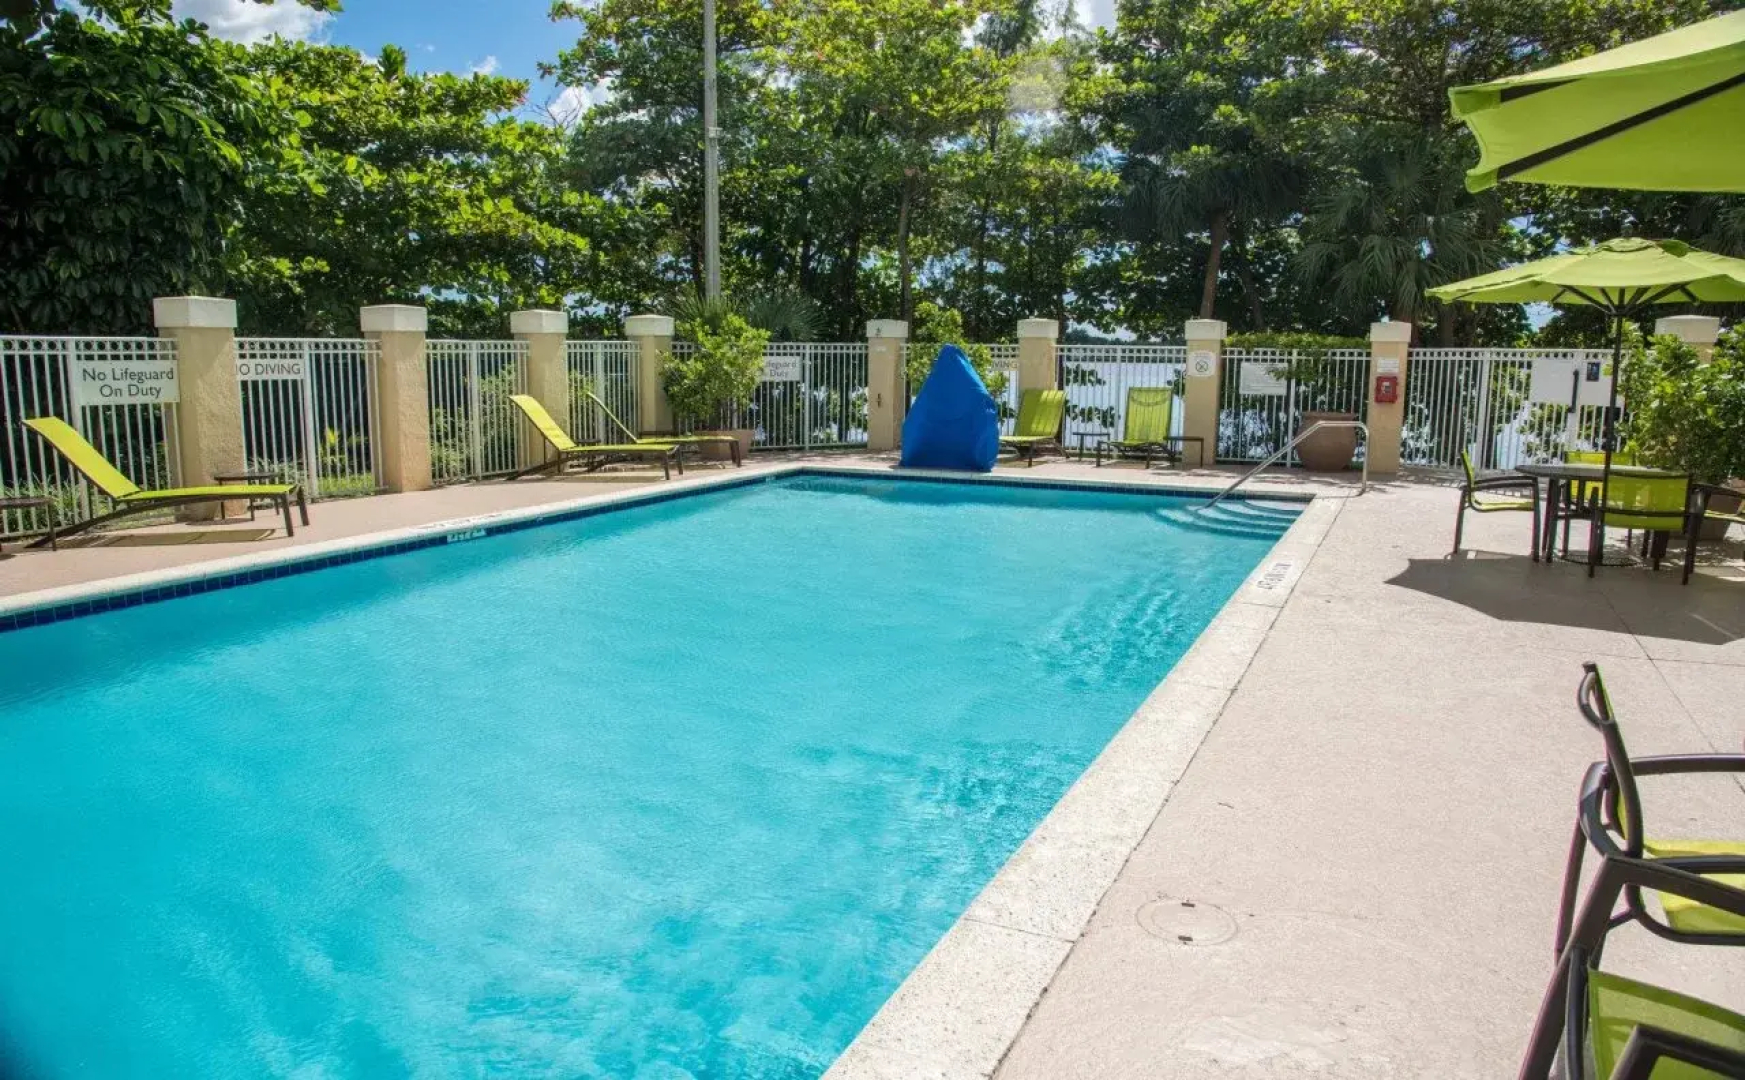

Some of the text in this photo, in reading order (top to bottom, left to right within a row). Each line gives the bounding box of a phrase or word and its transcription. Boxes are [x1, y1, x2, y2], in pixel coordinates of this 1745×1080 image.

[82, 367, 174, 384] No Lifeguard
[235, 363, 301, 376] O DIVING
[100, 384, 162, 399] On Duty
